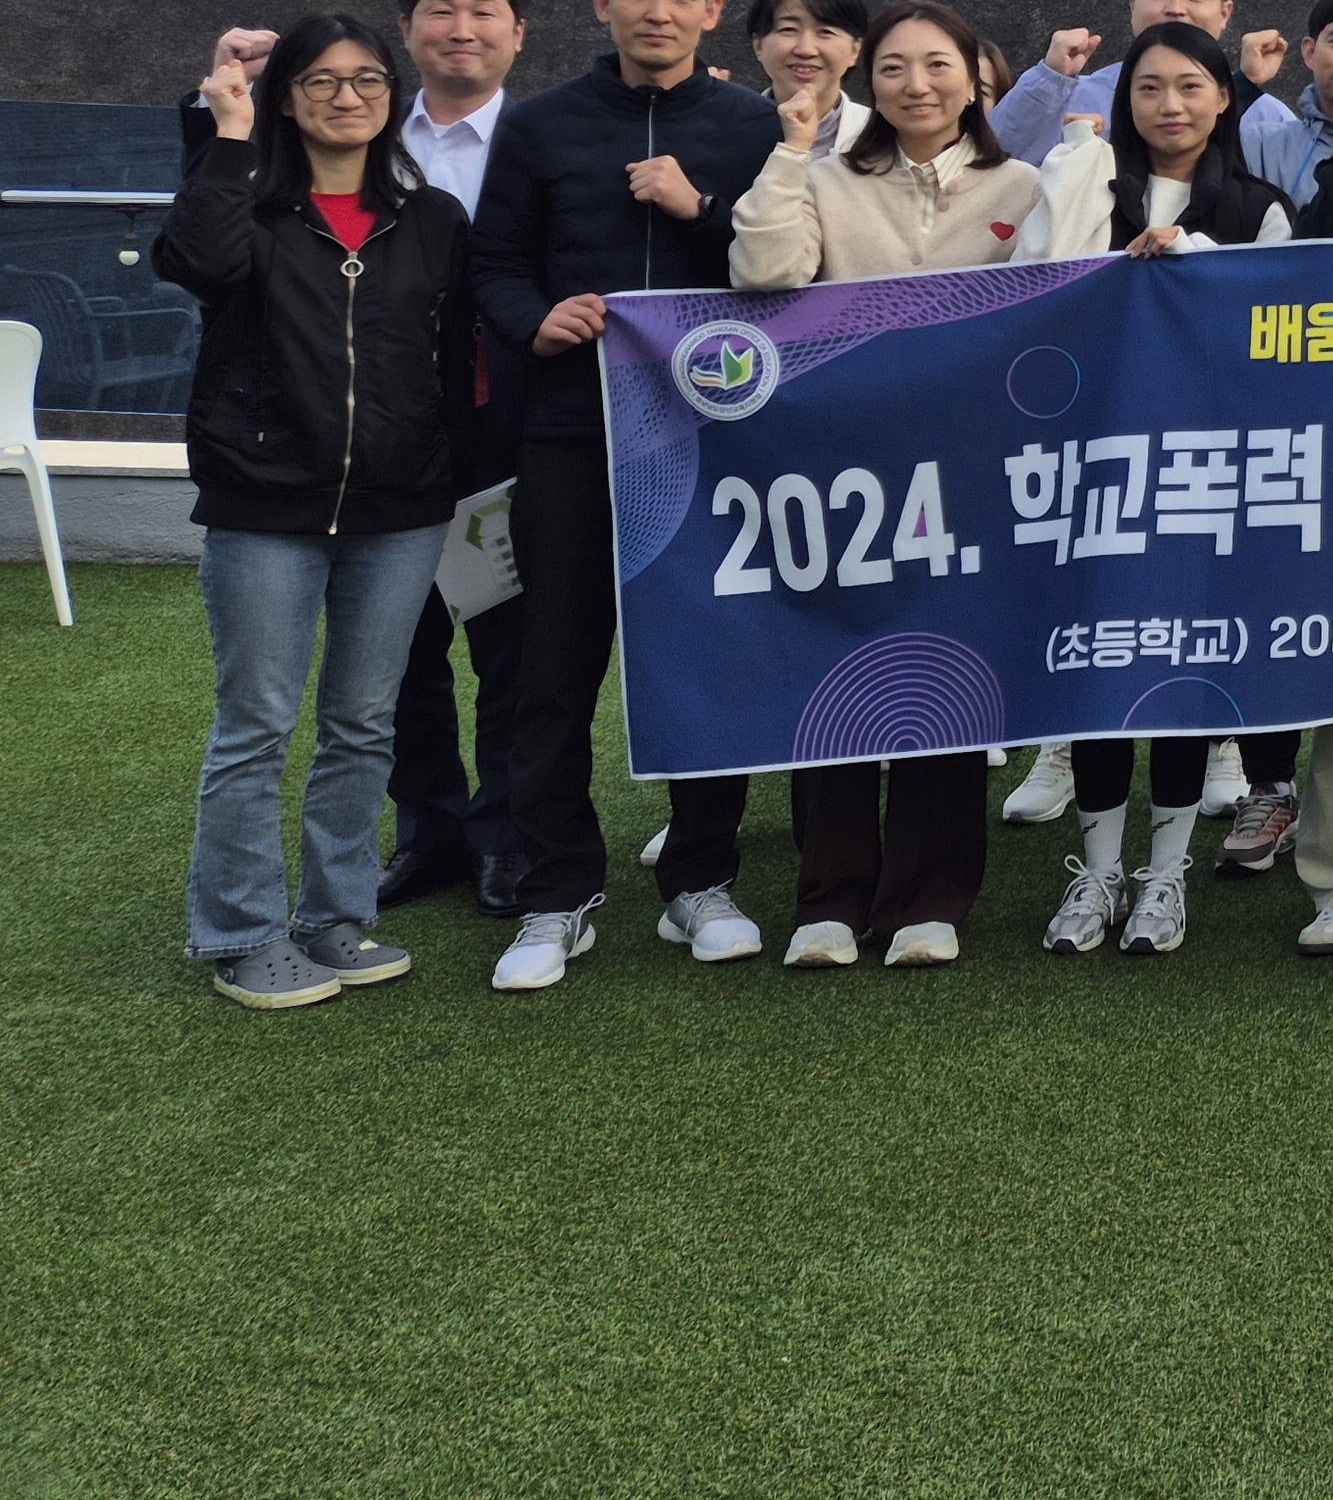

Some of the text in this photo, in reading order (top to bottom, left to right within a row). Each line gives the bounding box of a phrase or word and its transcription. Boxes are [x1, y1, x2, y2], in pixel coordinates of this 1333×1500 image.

[711, 460, 981, 597] 2024.
[1003, 423, 1325, 567] 학교폭력
[1045, 616, 1249, 674] (초등학교)
